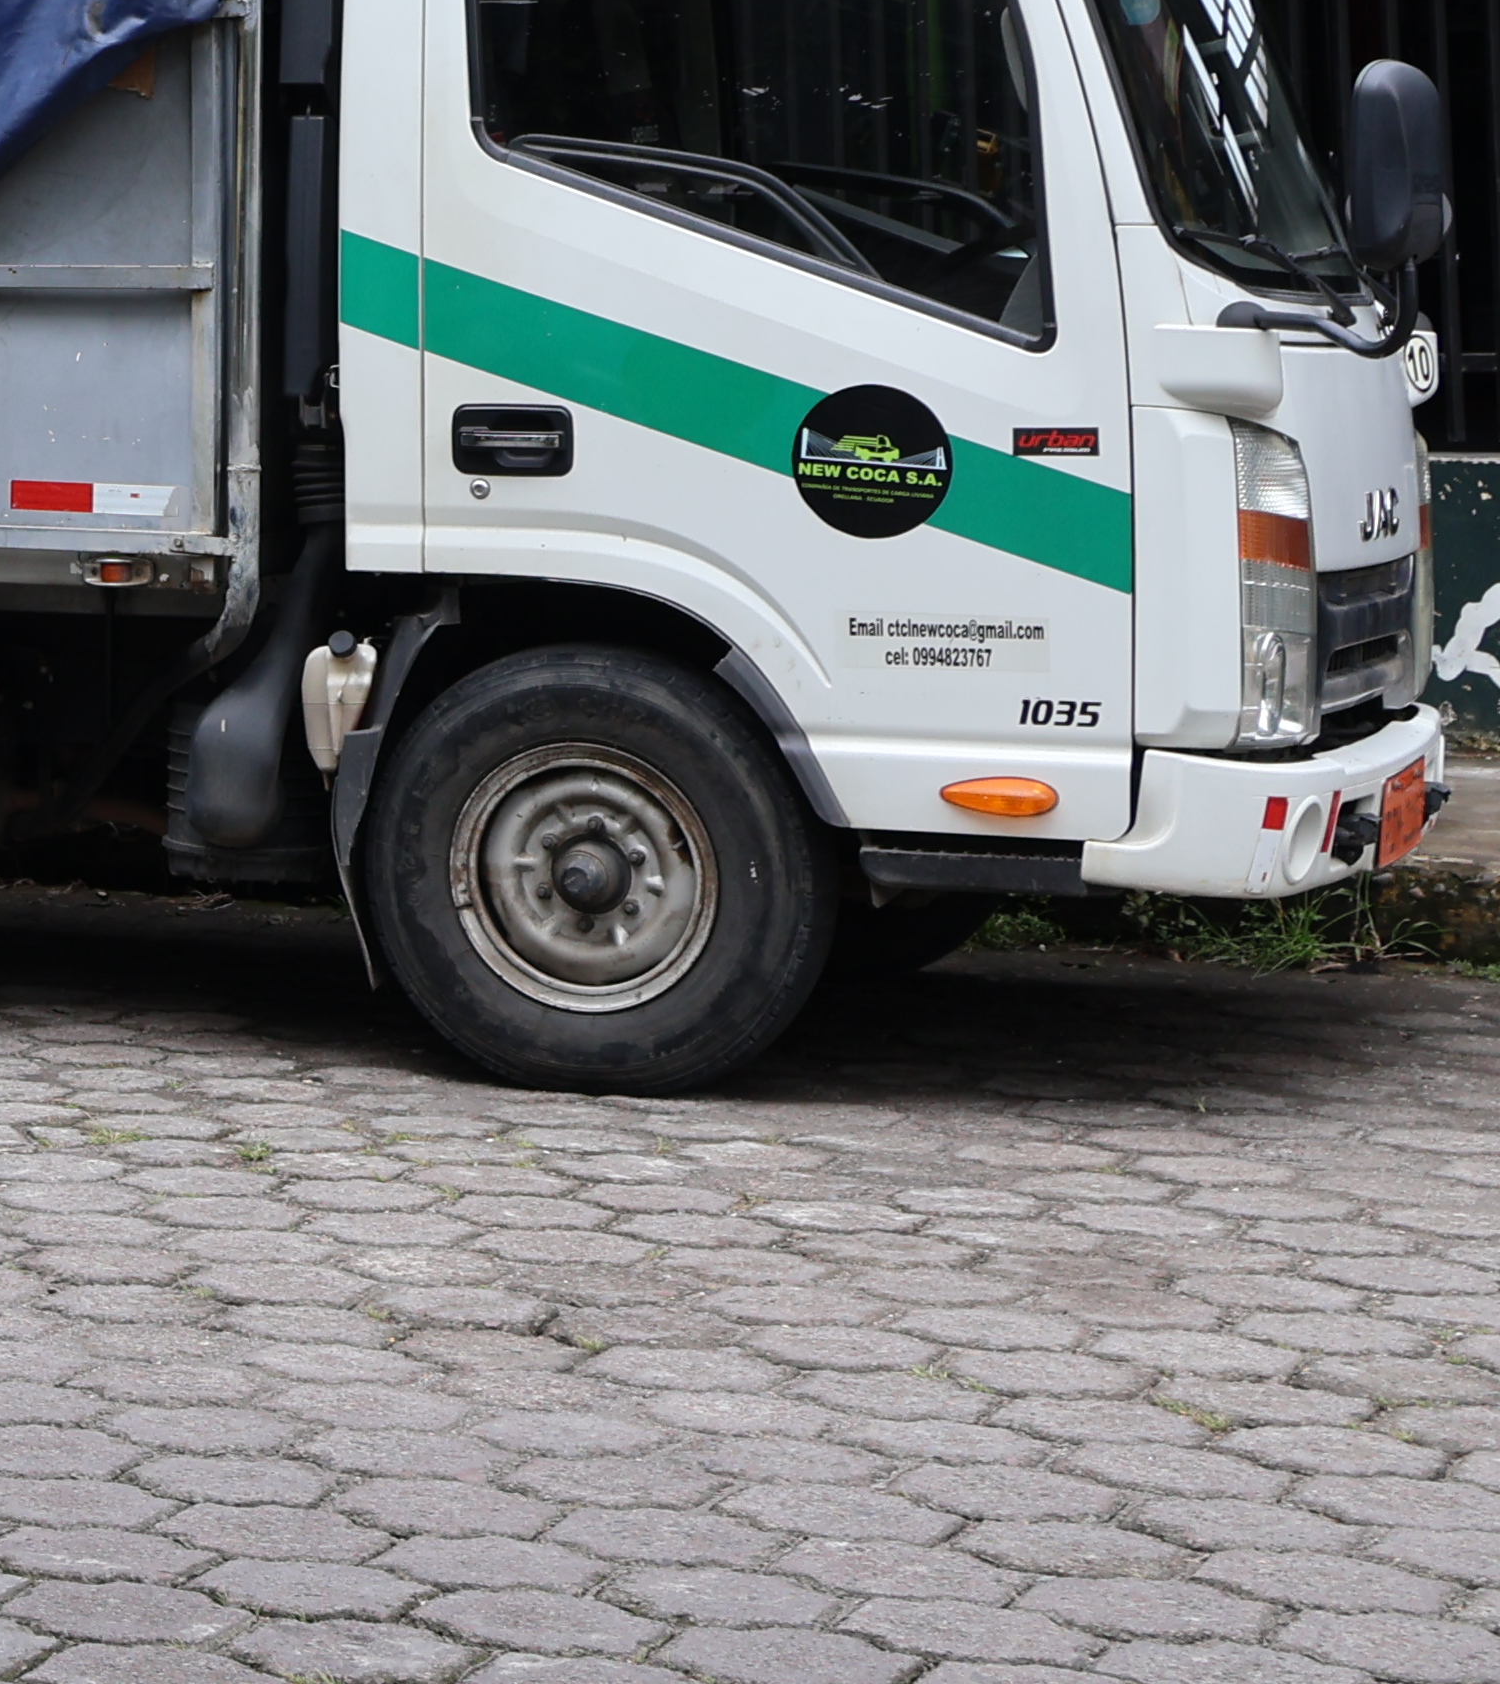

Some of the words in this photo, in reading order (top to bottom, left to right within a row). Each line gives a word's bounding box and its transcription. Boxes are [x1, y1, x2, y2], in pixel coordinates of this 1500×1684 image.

[1408, 345, 1430, 382] 10
[1017, 430, 1096, 448] urban
[797, 461, 841, 479] NEW
[846, 466, 900, 484] COCA
[905, 471, 943, 487] S.A.
[1357, 486, 1399, 542] JAC
[849, 617, 884, 637] Email
[885, 647, 909, 666] cel:
[913, 647, 992, 667] 0994823767
[1018, 699, 1102, 728] 1035
